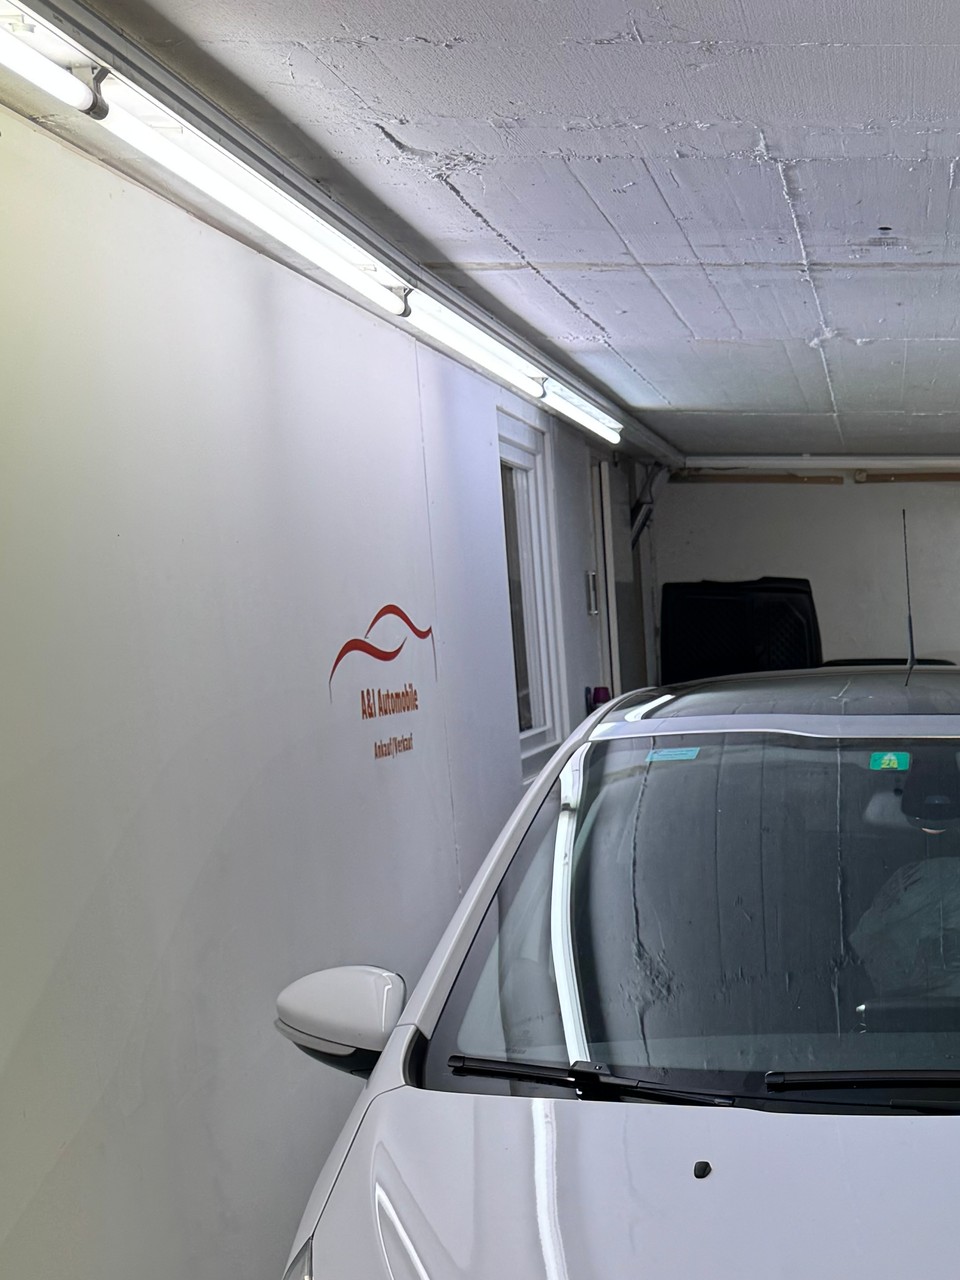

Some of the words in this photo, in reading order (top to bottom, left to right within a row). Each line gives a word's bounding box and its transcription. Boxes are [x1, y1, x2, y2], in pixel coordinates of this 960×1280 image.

[361, 688, 377, 720] A&I
[378, 683, 419, 717] Automobile
[374, 733, 414, 760] Ankauf/Verkauf
